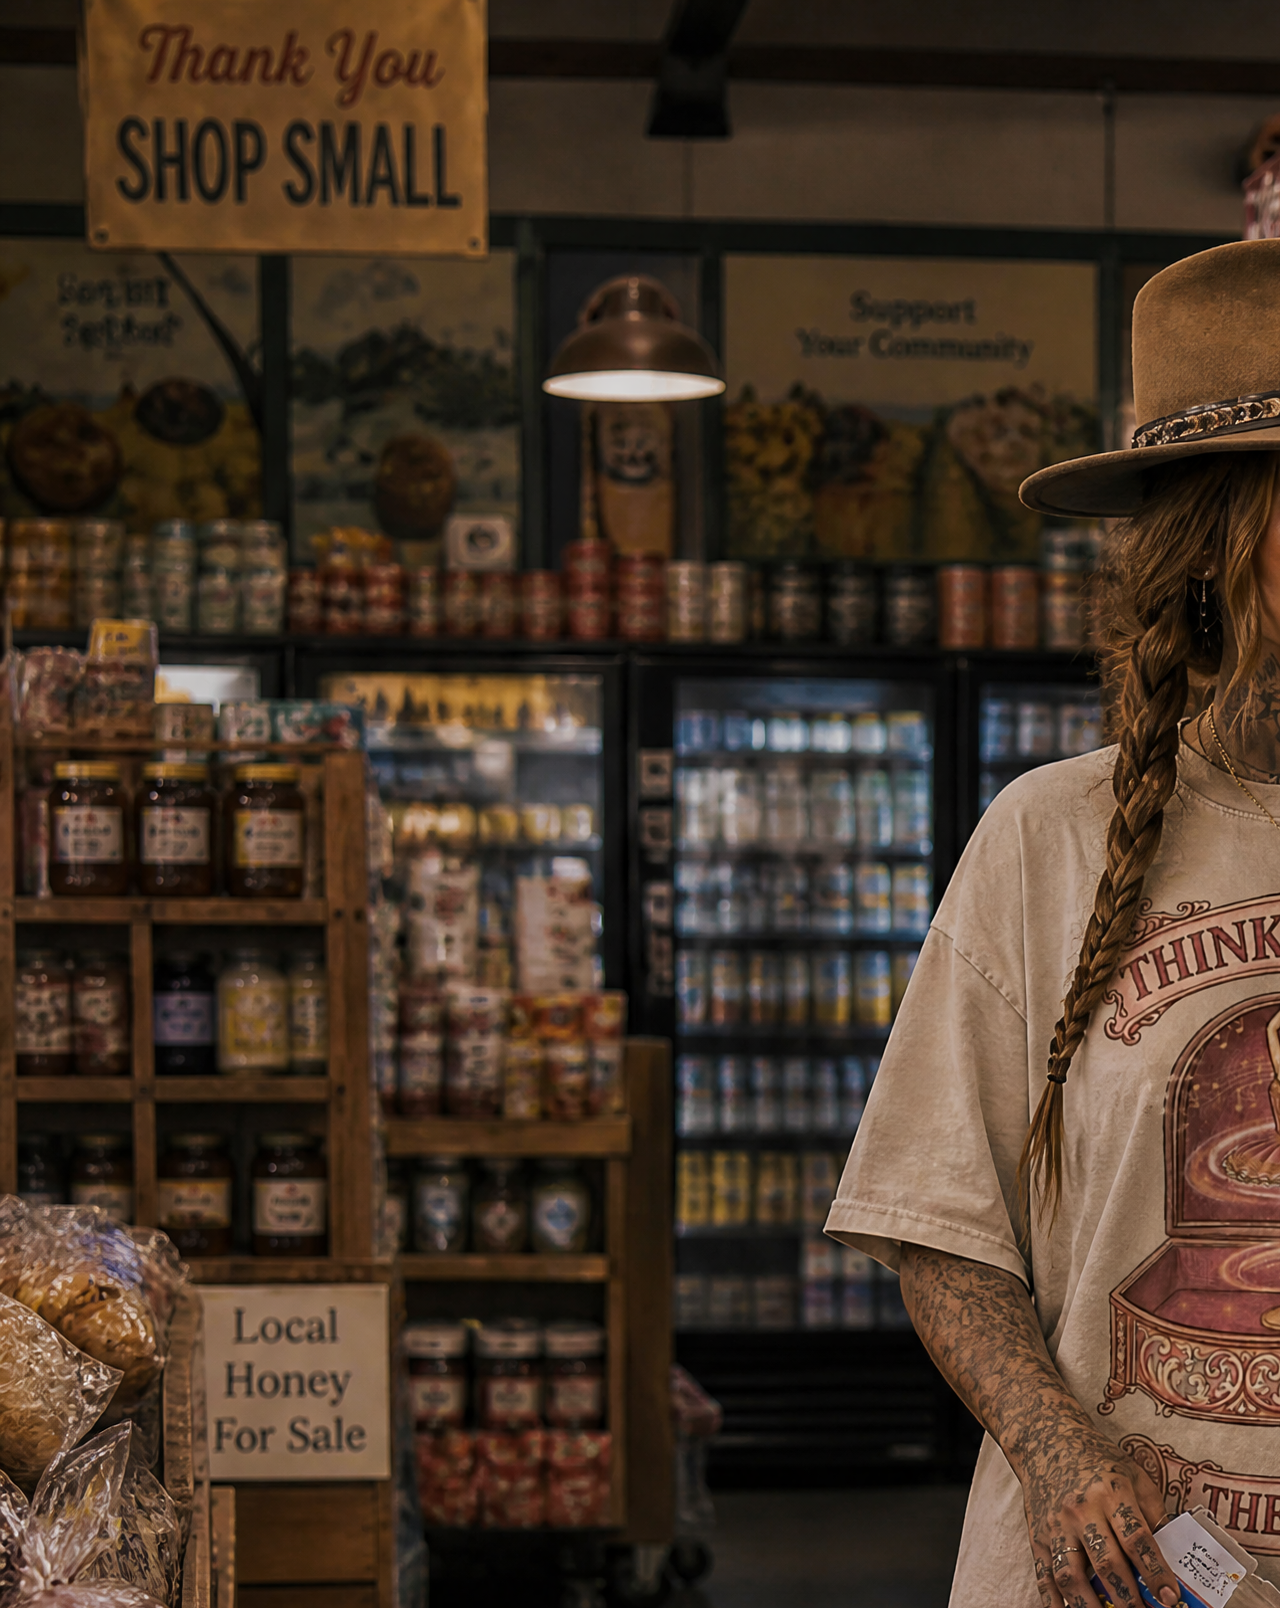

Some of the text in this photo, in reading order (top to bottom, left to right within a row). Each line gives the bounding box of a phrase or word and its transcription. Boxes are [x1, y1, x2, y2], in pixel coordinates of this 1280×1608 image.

[138, 23, 446, 109] Thank You
[116, 116, 463, 209] SHOP SMALL
[849, 290, 979, 330] Support
[870, 330, 1036, 369] Community
[233, 1306, 339, 1345] Local
[224, 1361, 351, 1405] Honey
[212, 1416, 366, 1455] For Sale
